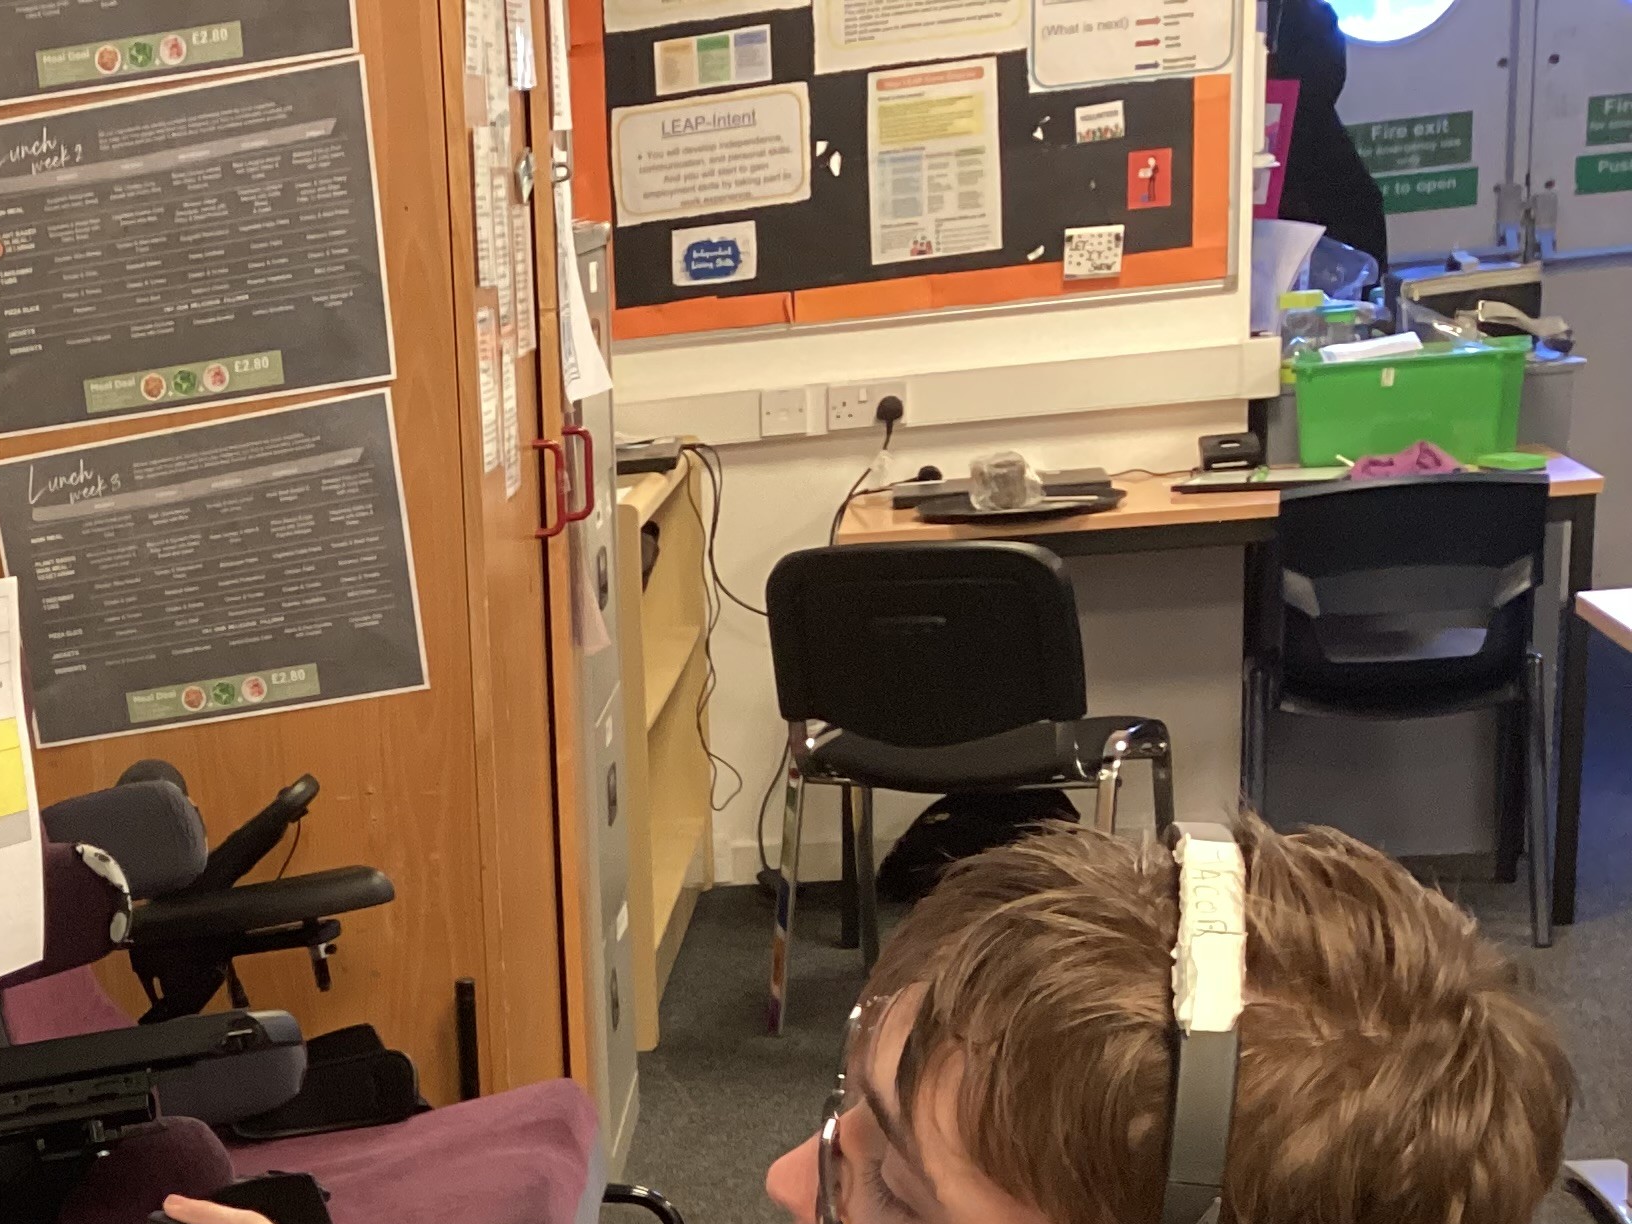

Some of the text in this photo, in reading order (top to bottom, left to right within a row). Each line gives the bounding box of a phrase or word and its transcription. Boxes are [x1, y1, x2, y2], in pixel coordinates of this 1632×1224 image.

[193, 28, 229, 46] £2.80
[661, 109, 756, 138] LEAP-Intent
[1371, 118, 1449, 141] Fire exit
[31, 146, 70, 176] week
[1394, 178, 1456, 195] to open
[234, 357, 270, 375] £2.80
[28, 458, 94, 504] Lunch
[69, 478, 107, 504] week
[271, 669, 306, 685] £2.80
